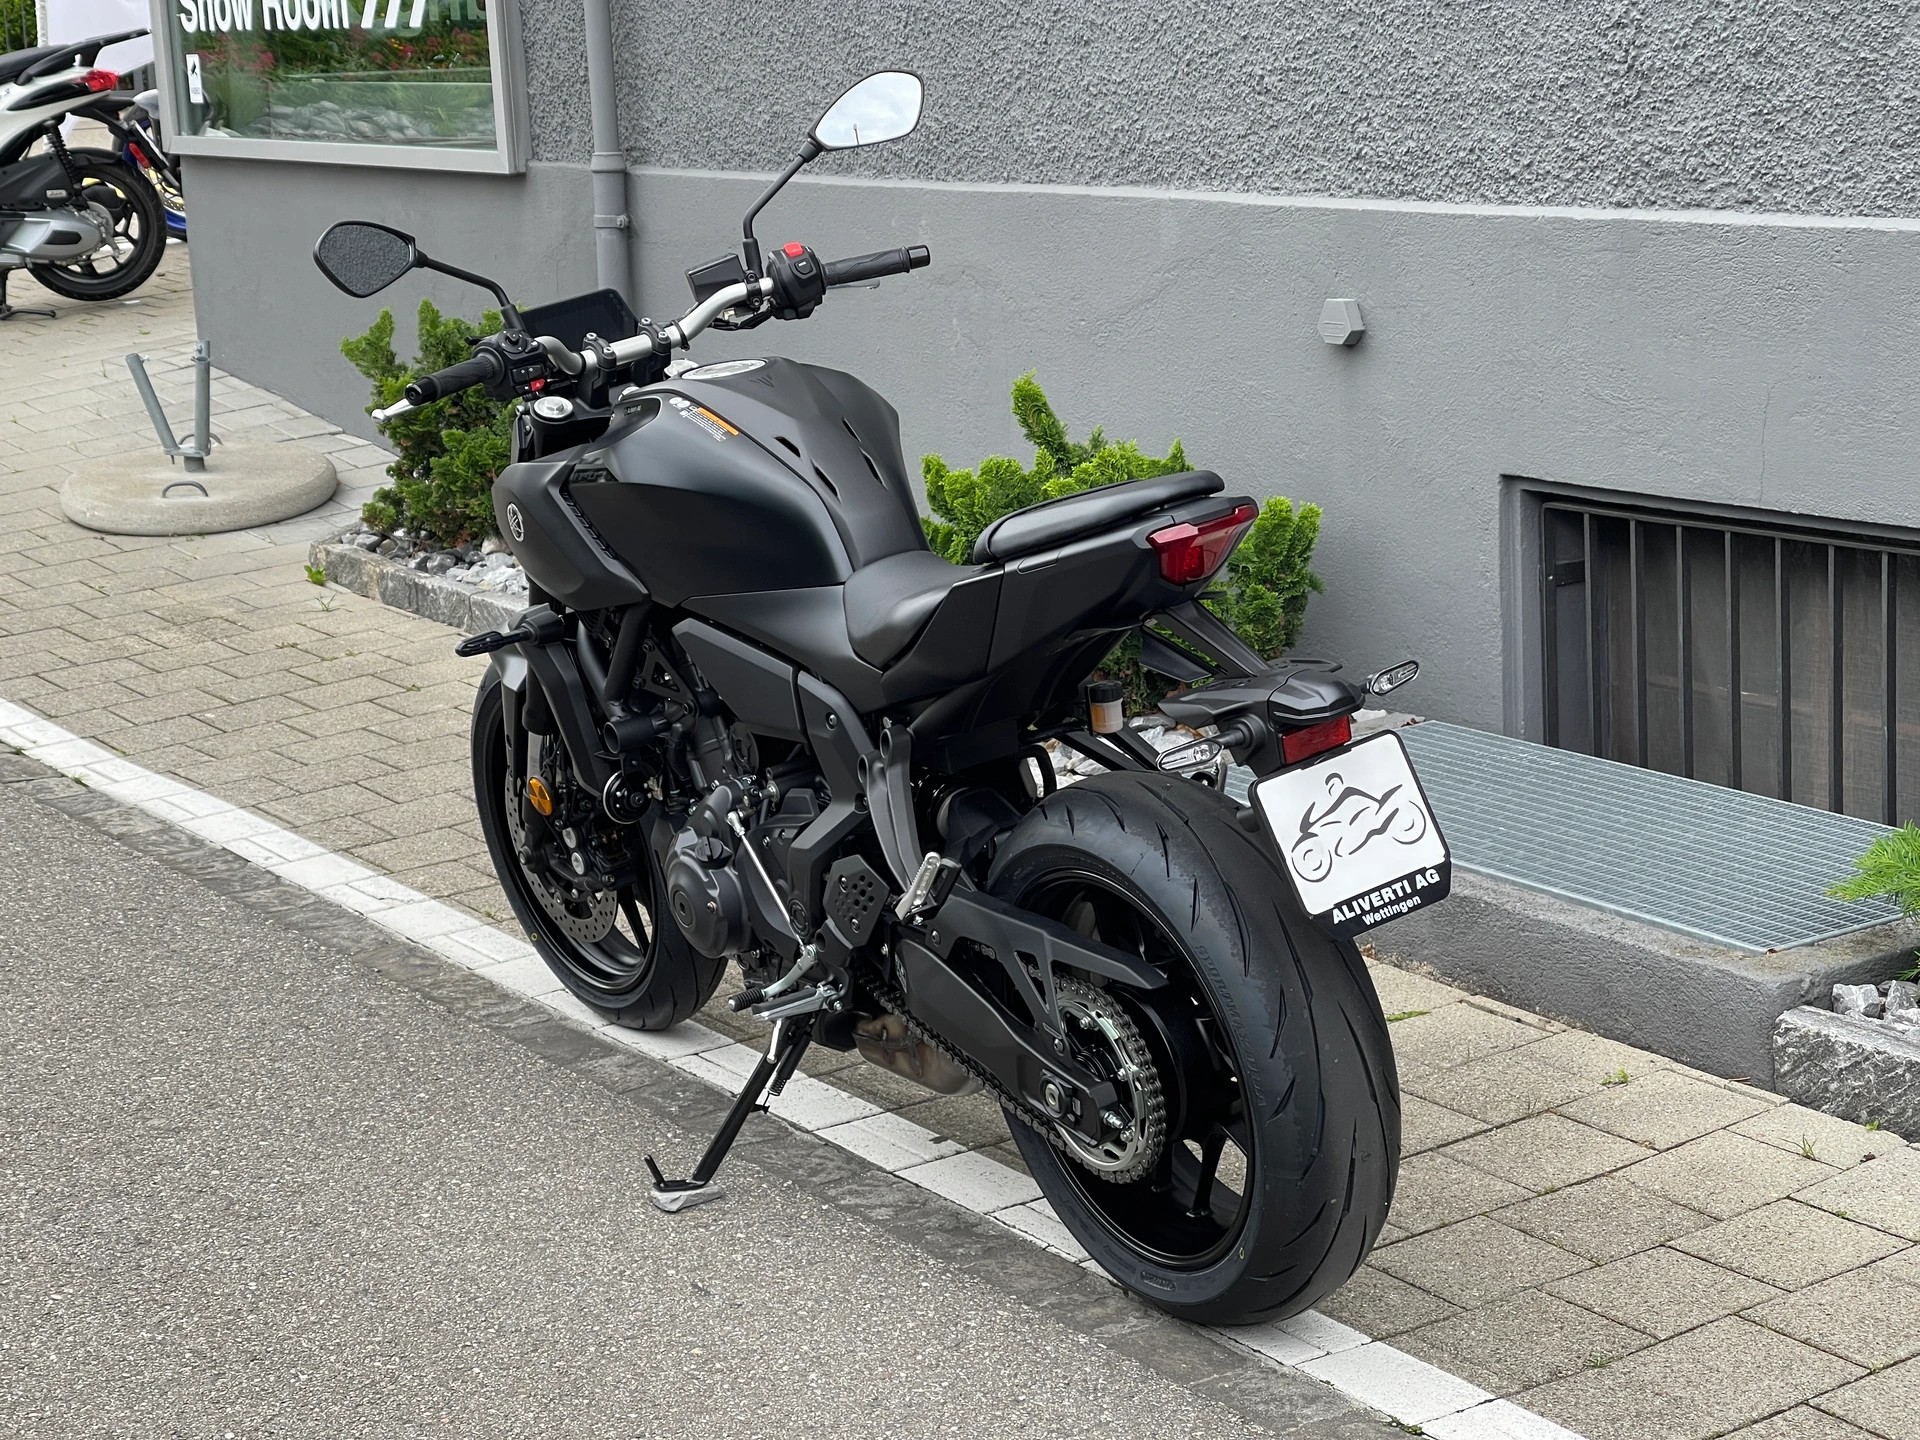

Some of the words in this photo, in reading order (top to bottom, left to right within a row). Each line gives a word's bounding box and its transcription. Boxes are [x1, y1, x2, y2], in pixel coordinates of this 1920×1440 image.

[261, 0, 350, 31] Room
[1332, 879, 1412, 924] ALIVERTI
[1415, 868, 1441, 890] AG
[1362, 895, 1421, 926] Wettingen
